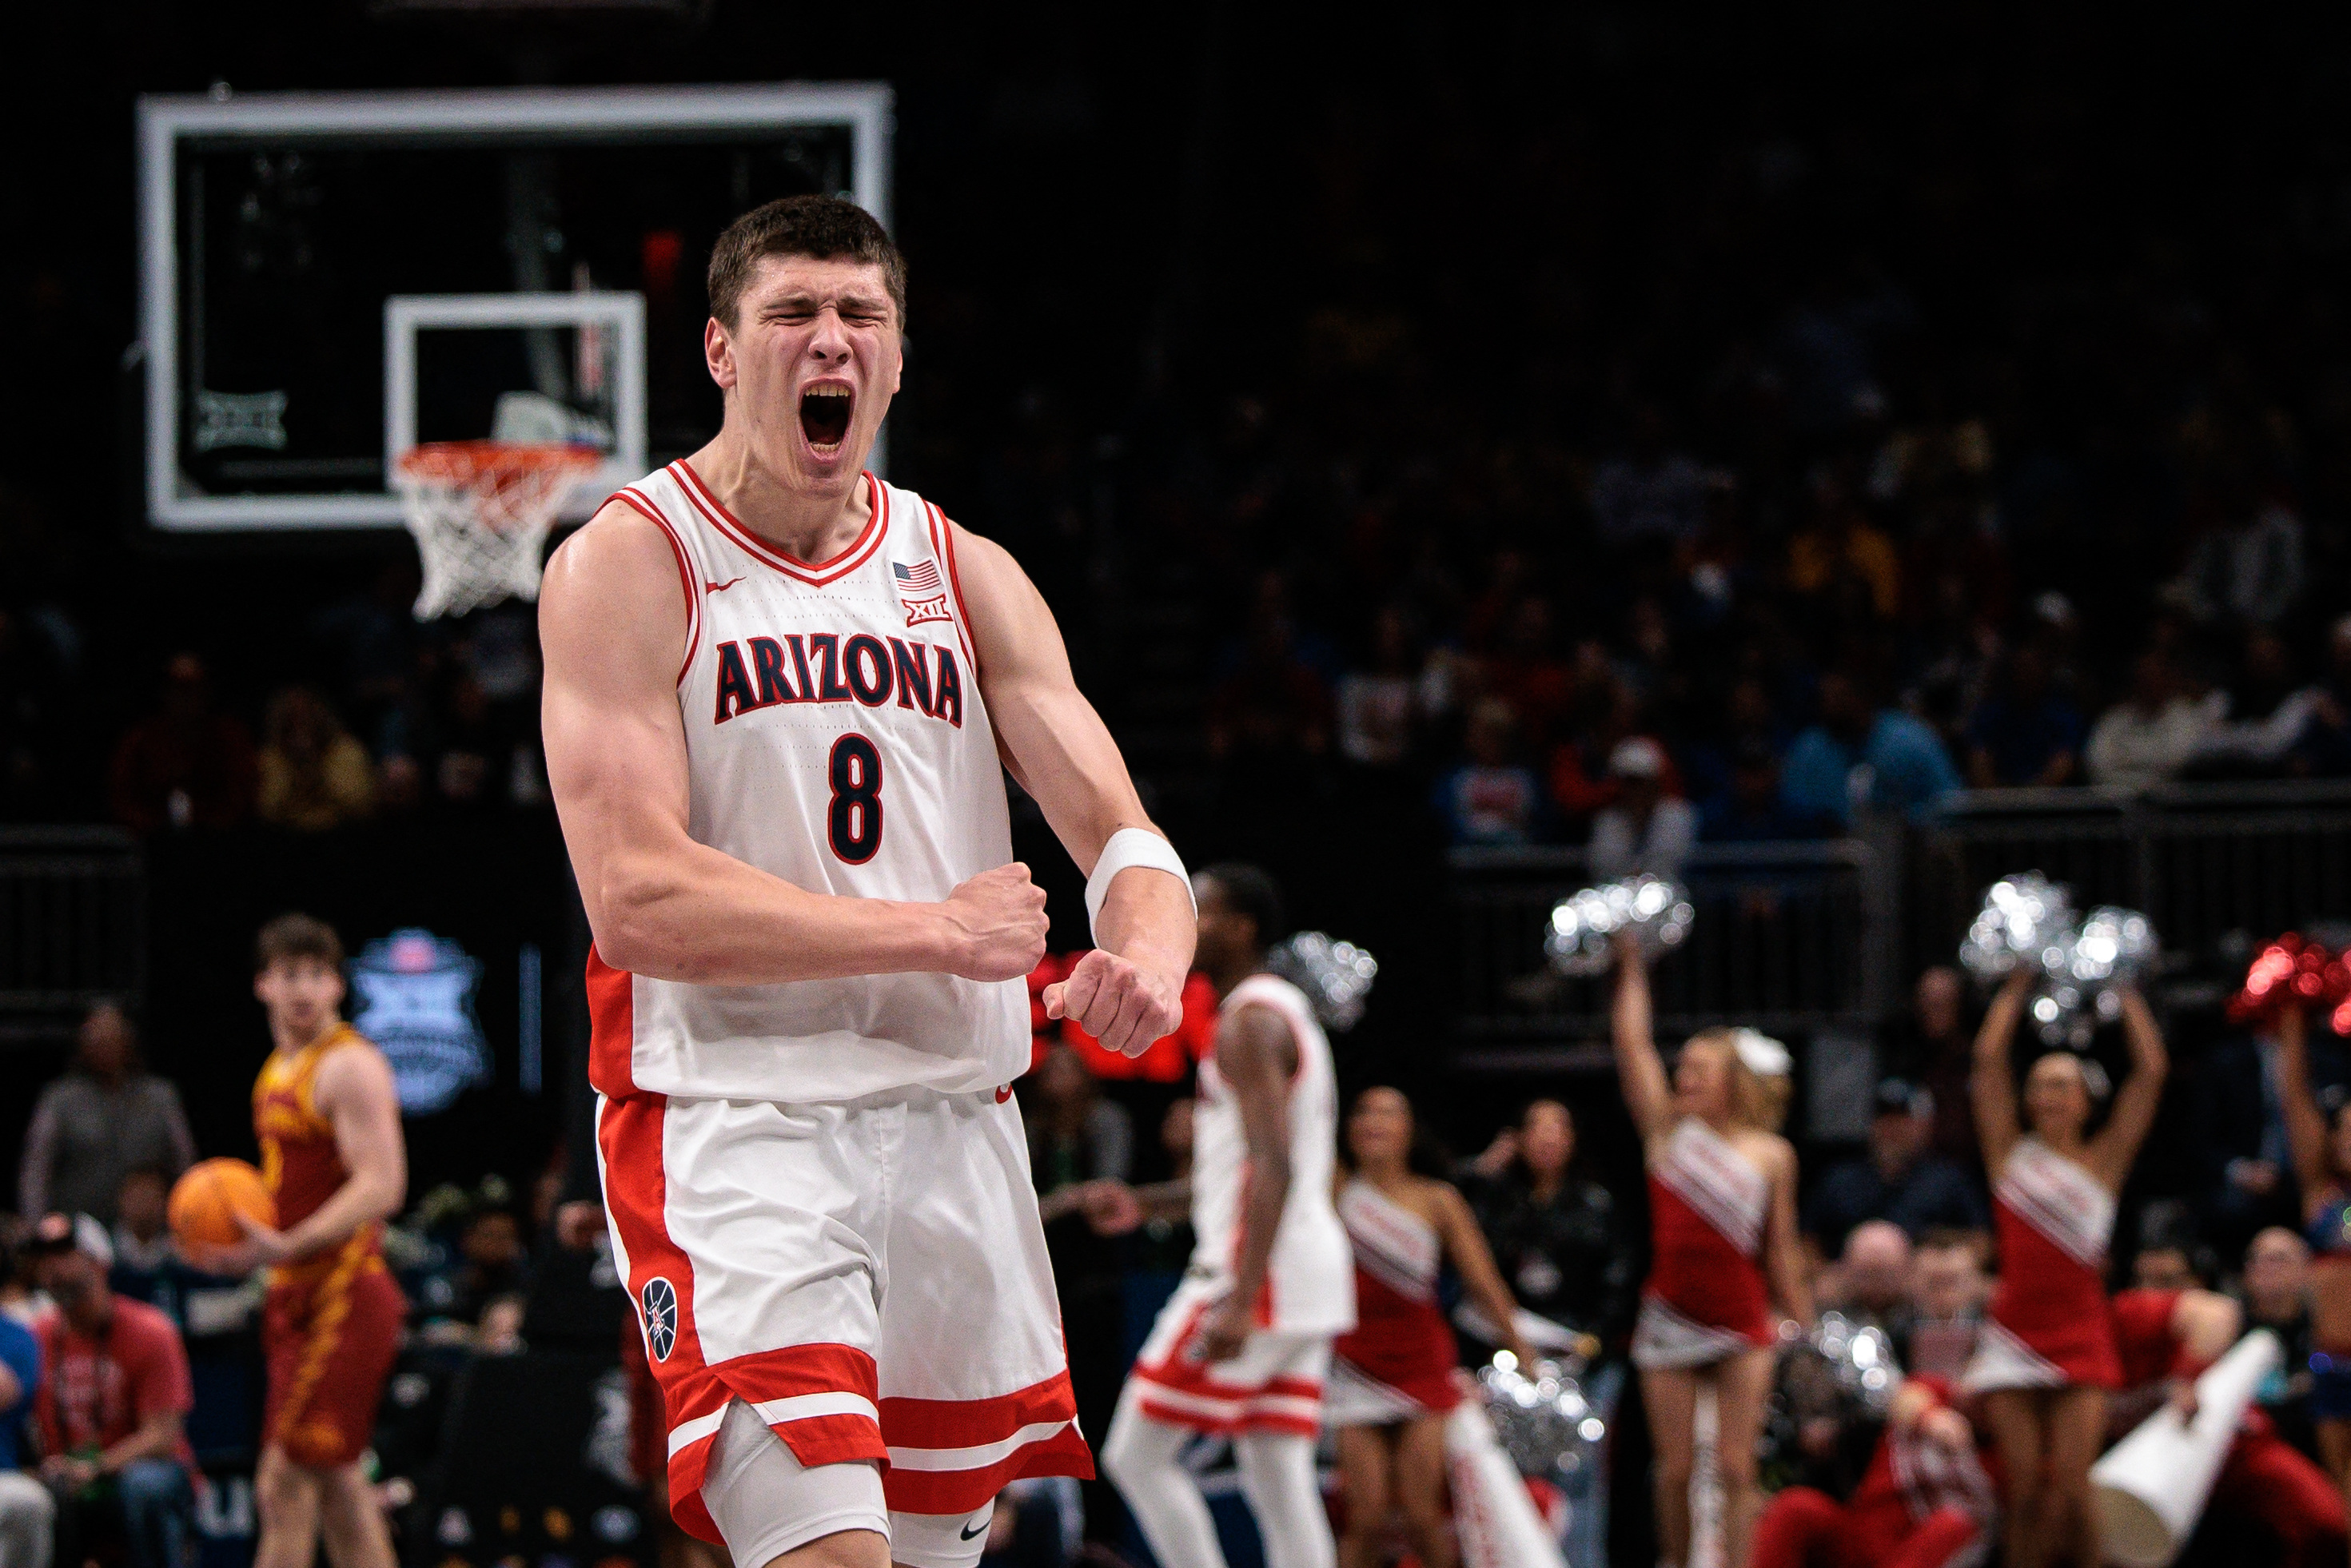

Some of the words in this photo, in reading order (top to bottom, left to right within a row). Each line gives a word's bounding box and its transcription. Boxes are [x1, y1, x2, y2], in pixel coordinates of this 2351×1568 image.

[902, 592, 953, 627] XII
[715, 633, 962, 729] ARIZONA
[827, 732, 883, 866] 8
[649, 1300, 665, 1340] A
